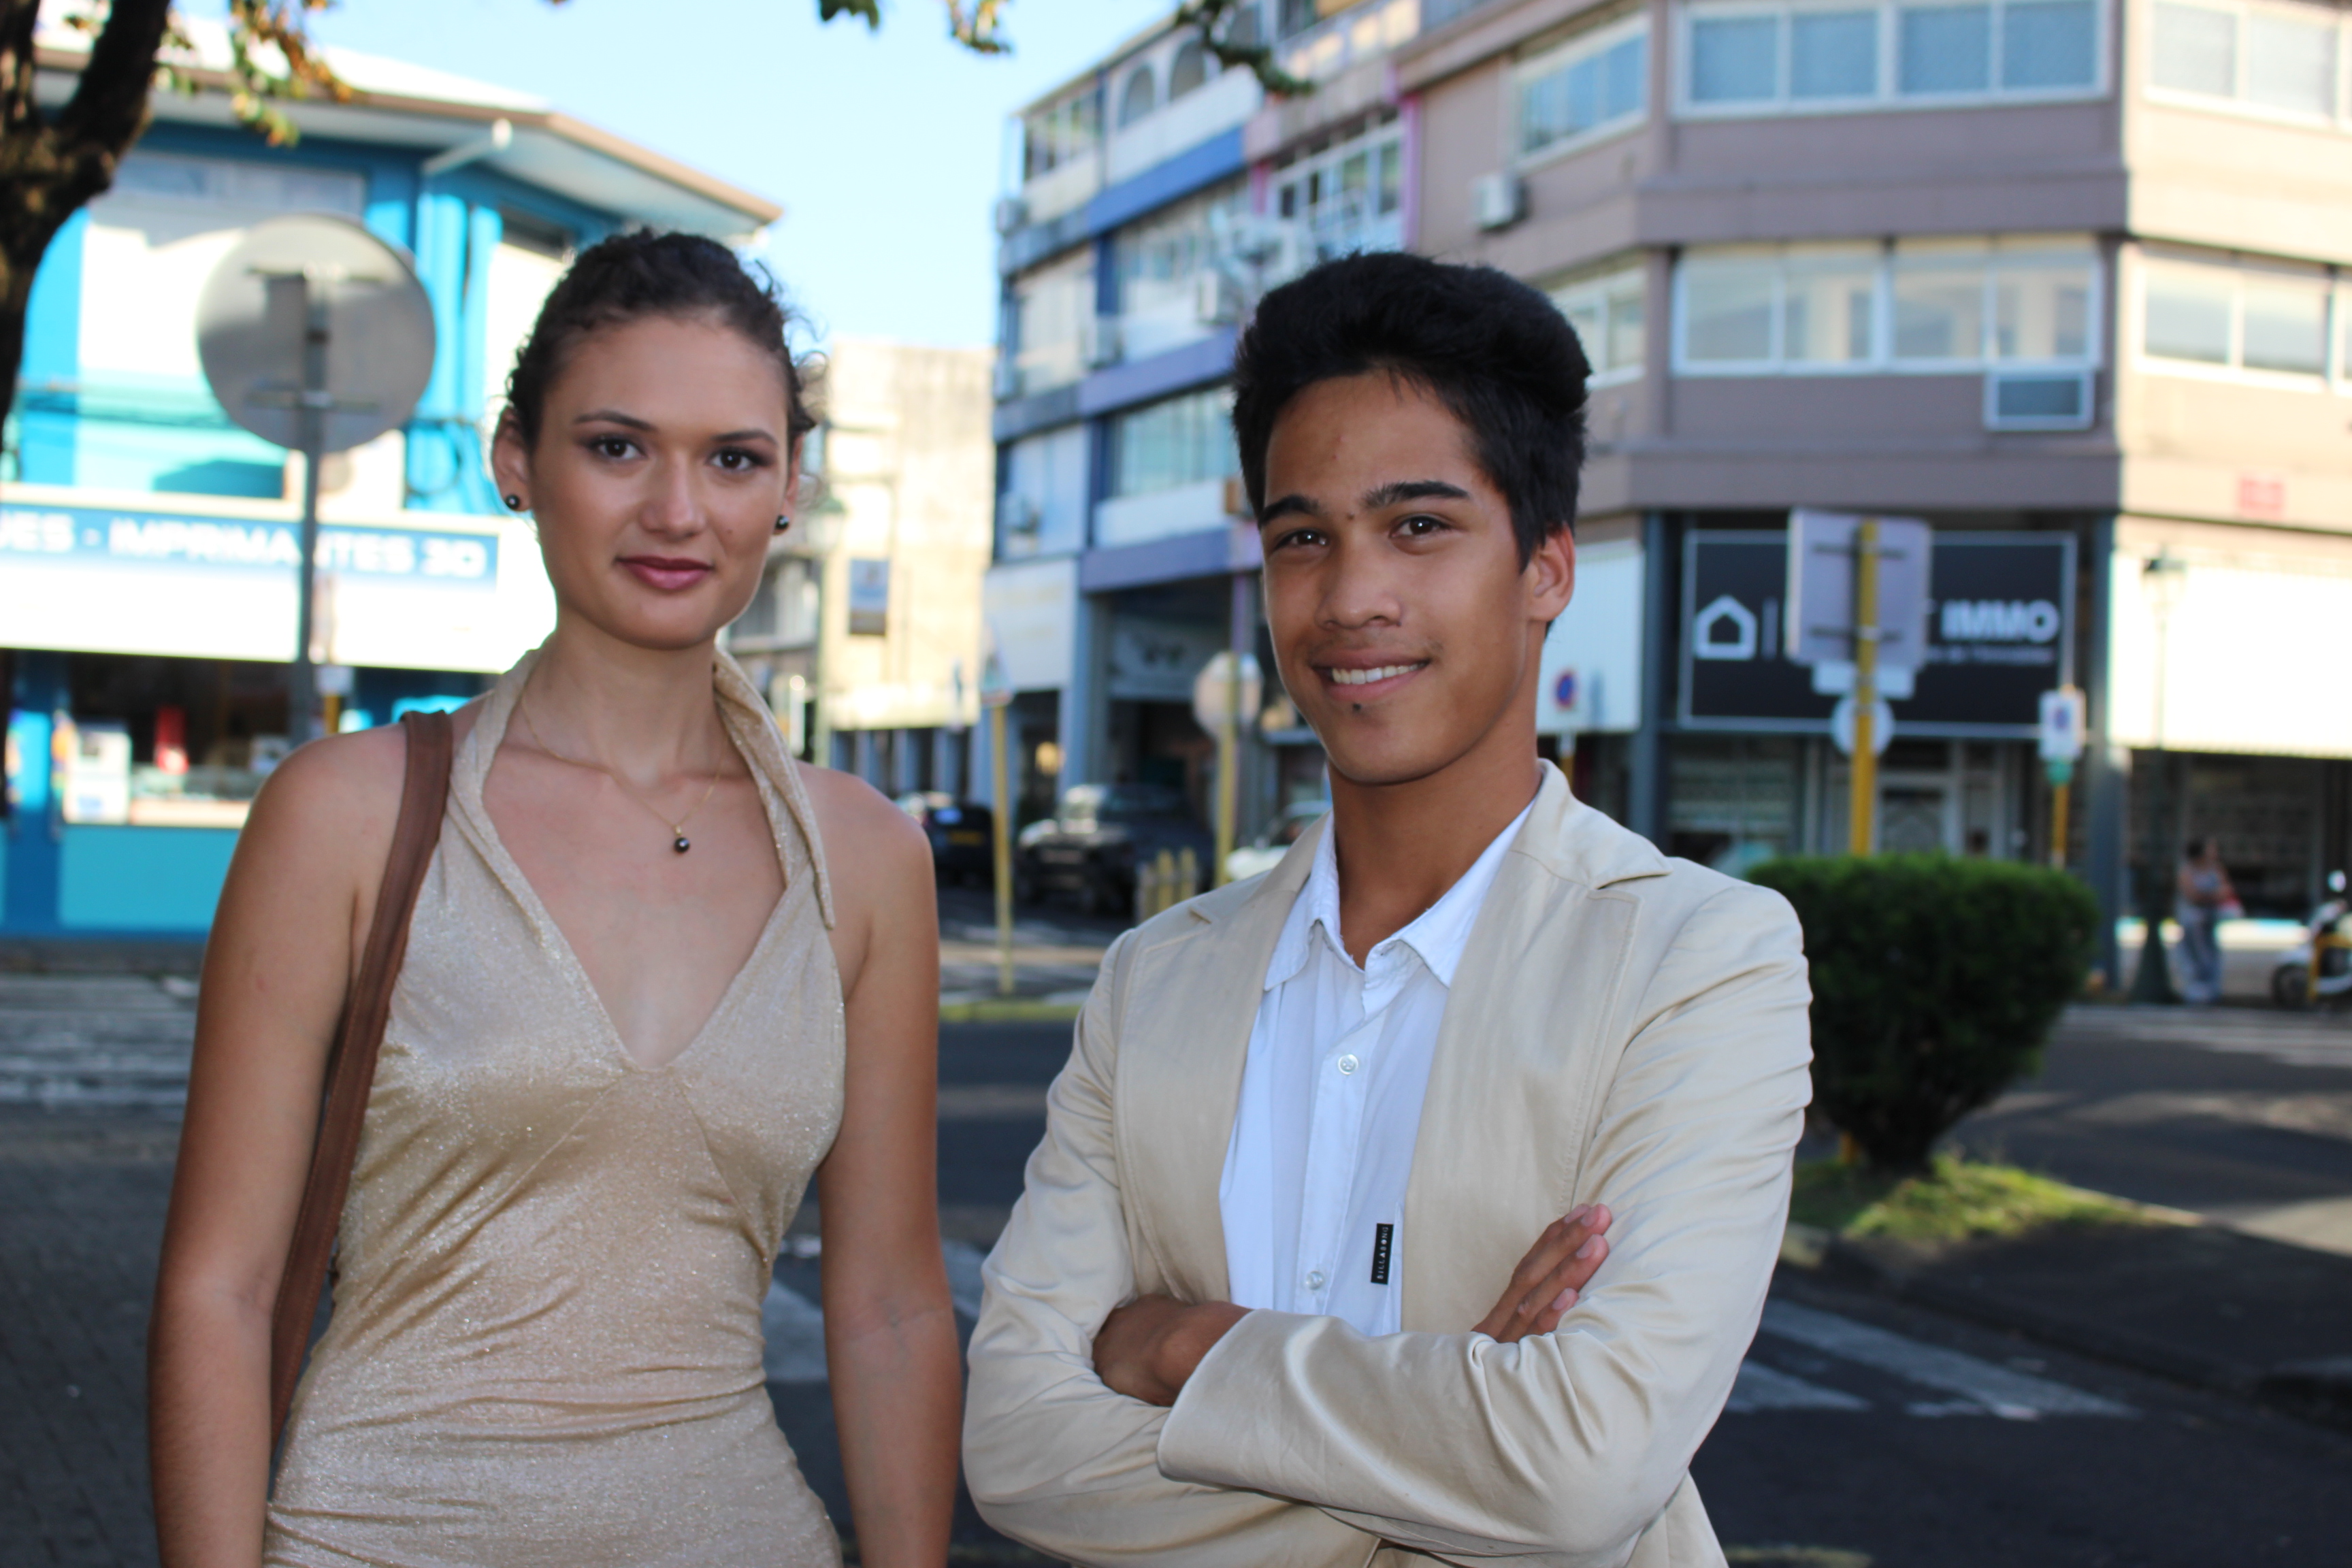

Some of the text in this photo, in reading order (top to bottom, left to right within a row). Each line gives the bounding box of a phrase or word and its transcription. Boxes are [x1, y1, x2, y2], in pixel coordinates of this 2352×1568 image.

[421, 538, 488, 579] 3D
[1942, 599, 2059, 644] IMMO
[1377, 1226, 1389, 1279] BILLABONG
